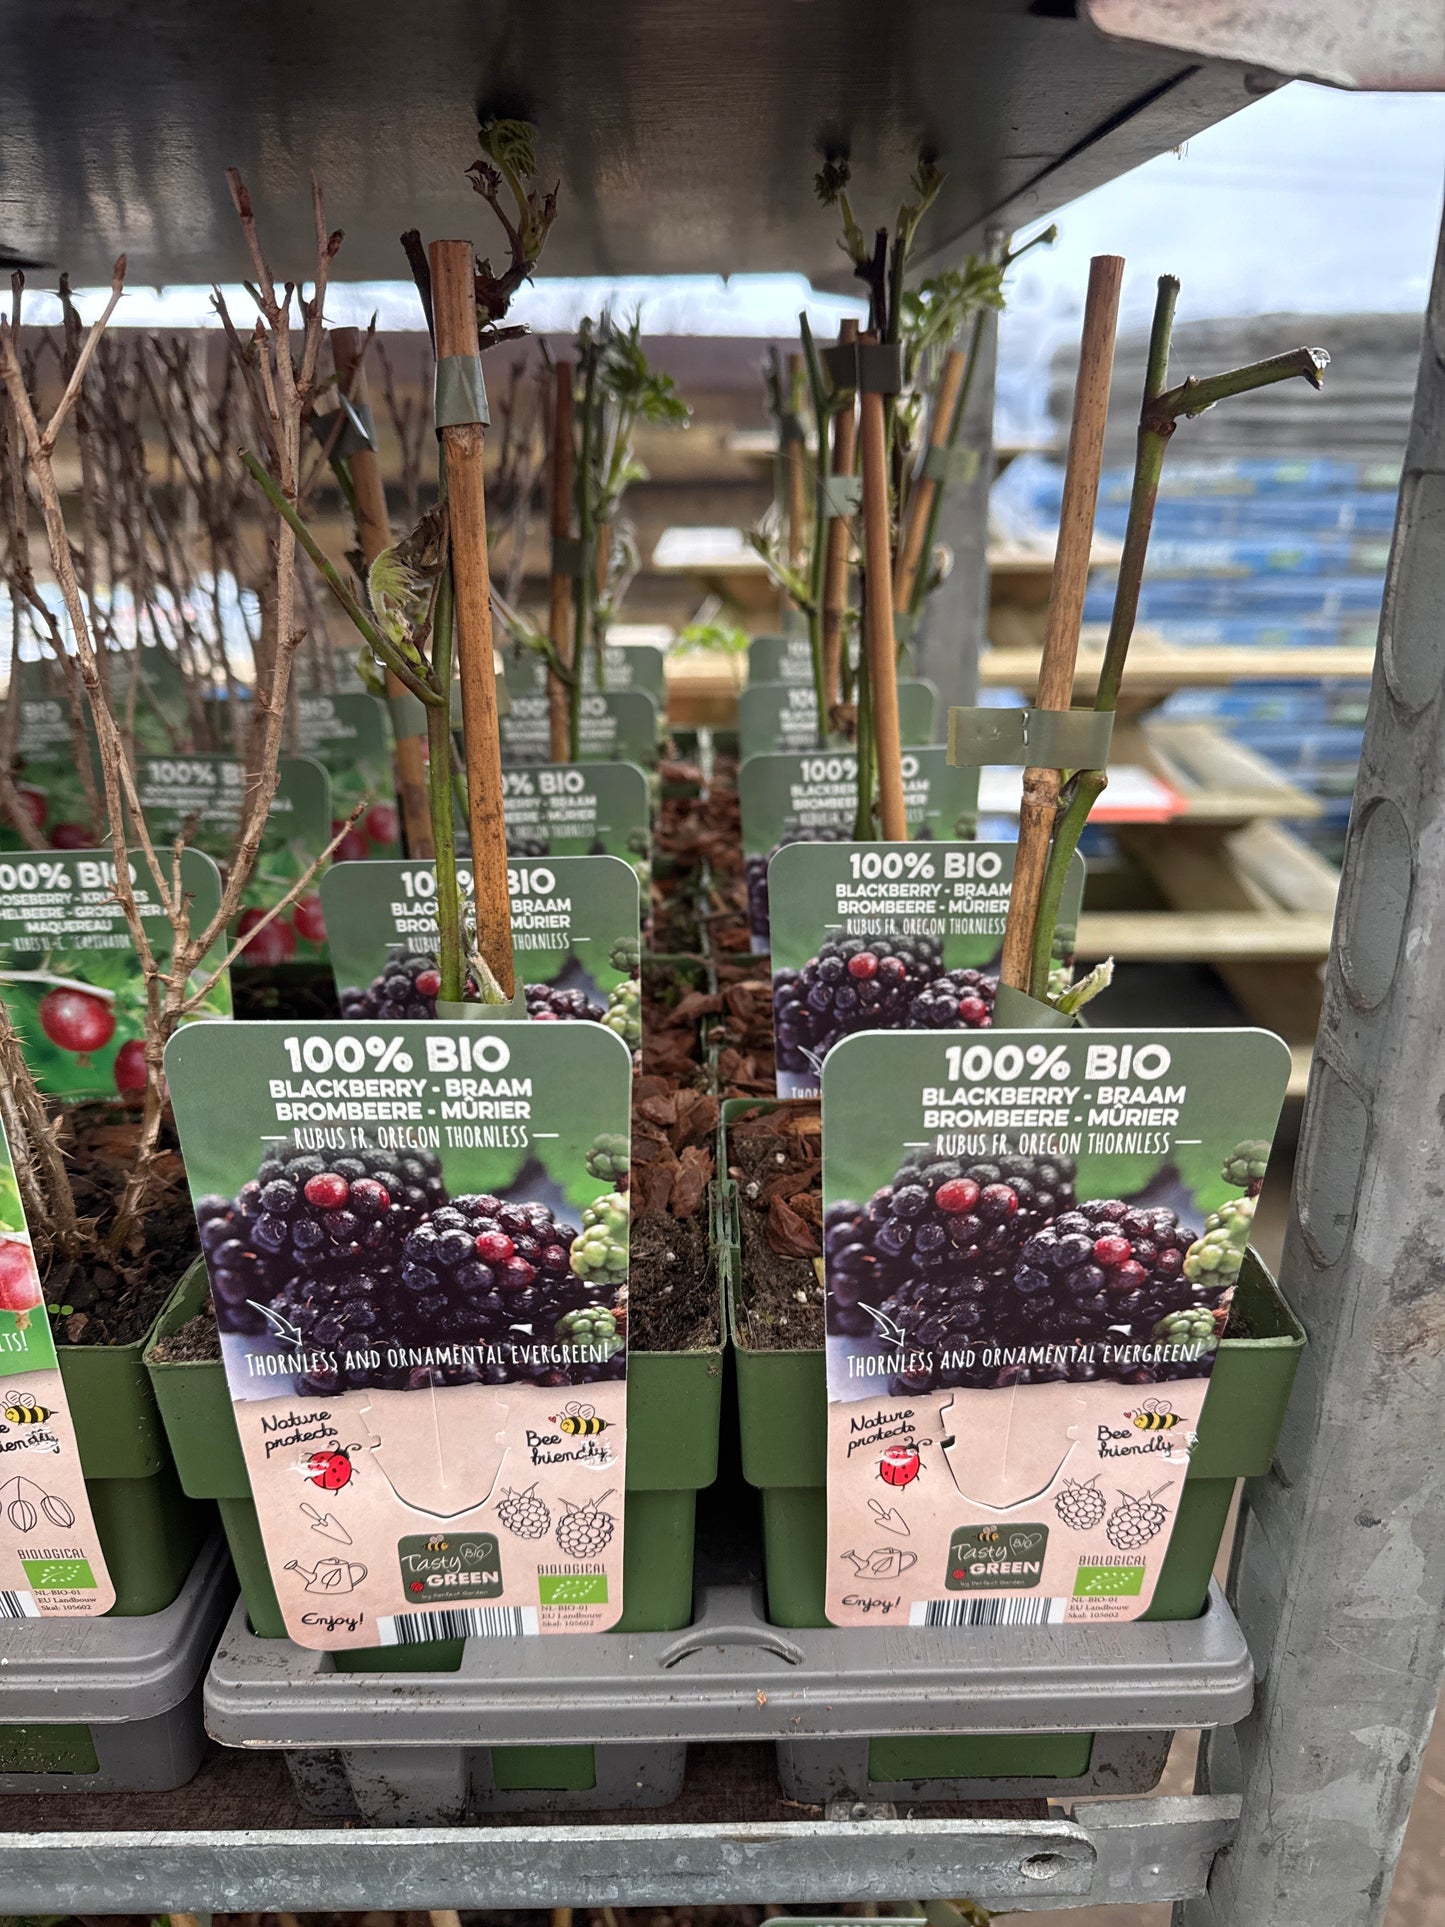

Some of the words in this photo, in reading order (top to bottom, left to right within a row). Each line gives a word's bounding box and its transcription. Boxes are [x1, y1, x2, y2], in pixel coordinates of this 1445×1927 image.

[538, 769, 586, 794] BIO
[850, 853, 935, 880] 100%
[944, 852, 1002, 878] BIO
[835, 883, 942, 898] BLACKBERRY
[954, 882, 1012, 897] BRAAM
[511, 898, 571, 914] BRAAM
[837, 899, 936, 914] BROMBEERE
[949, 896, 1010, 913] MÛRIER
[511, 913, 571, 930] MÛRIER
[847, 918, 881, 935] RUBUS
[884, 918, 899, 935] FR.
[902, 918, 946, 935] OREGON
[949, 917, 1006, 935] THORNLESS
[513, 932, 569, 951] THORNLESS
[284, 1036, 413, 1073] 100%
[425, 1035, 511, 1073] BIO
[945, 1044, 1071, 1081] 100%
[1085, 1044, 1172, 1080] BIO
[269, 1079, 427, 1099] BLACKBERRY
[446, 1079, 532, 1097] BRAAM
[922, 1087, 1080, 1106] BLACKBERRY
[1097, 1086, 1186, 1104] BRAAM
[276, 1102, 422, 1121] BROMBEERE
[442, 1096, 530, 1120] MÛRIER
[923, 1108, 1069, 1128] BROMBEERE
[1088, 1103, 1179, 1127] MÛRIER
[294, 1127, 346, 1150] RUBUS
[350, 1126, 373, 1149] FR.
[378, 1126, 441, 1149] OREGON
[445, 1125, 529, 1149] THORNLESS
[936, 1134, 986, 1156] RUBUS
[992, 1134, 1013, 1156] FR.
[1019, 1133, 1080, 1155] OREGON
[1087, 1132, 1170, 1155] THORNLESS
[245, 1350, 338, 1378] THORNLESS
[345, 1349, 380, 1370] AND
[389, 1344, 505, 1368] ORNAMENTAL
[511, 1341, 609, 1365] EVERGREEN!
[847, 1351, 933, 1379] THORNLESS
[940, 1349, 975, 1370] AND
[982, 1344, 1095, 1368] ORNAMENTAL
[1103, 1341, 1201, 1364] EVERGREEN!
[261, 1410, 332, 1434] Nature
[850, 1408, 915, 1435] Nature
[265, 1427, 338, 1458] protects
[526, 1430, 561, 1447] Bee
[847, 1423, 916, 1457] protects
[1097, 1425, 1132, 1441] Bee
[1098, 1435, 1174, 1459] friendly
[17, 1548, 86, 1559] BIOLOGICAL
[465, 1548, 484, 1558] BIO
[951, 1543, 1007, 1563] Tasty
[1013, 1539, 1032, 1548] BIO
[401, 1554, 461, 1573] Tasty
[537, 1563, 607, 1575] BIOLOGICAL
[969, 1561, 1040, 1575] GREEN
[1078, 1555, 1147, 1566] BIOLOGICAL
[426, 1571, 498, 1587] GREEN
[841, 1595, 901, 1613] Enjoy!
[301, 1612, 364, 1635] Enjoy!
